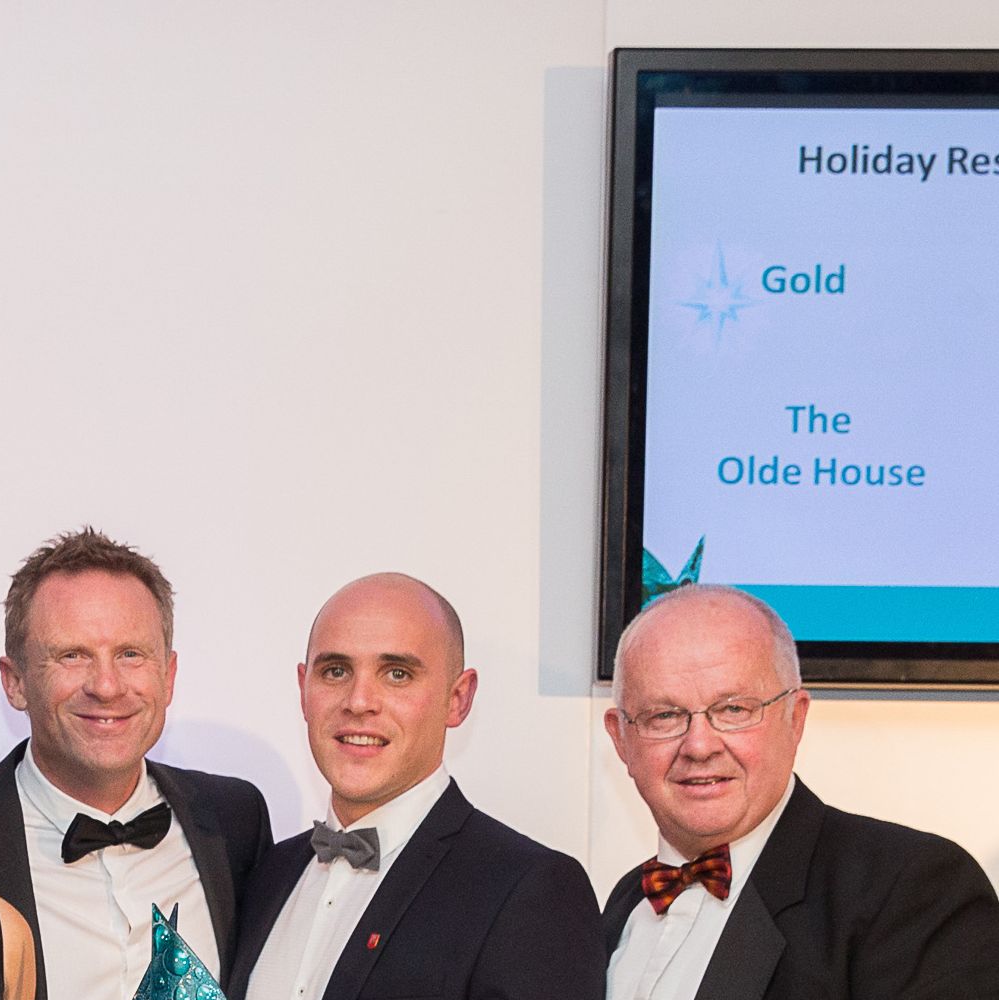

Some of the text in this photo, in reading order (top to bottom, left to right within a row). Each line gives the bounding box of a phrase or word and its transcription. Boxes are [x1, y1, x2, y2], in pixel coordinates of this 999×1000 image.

[798, 143, 937, 183] Holiday
[761, 263, 847, 295] Gold
[785, 403, 852, 435] The
[716, 454, 926, 487] Olde House
